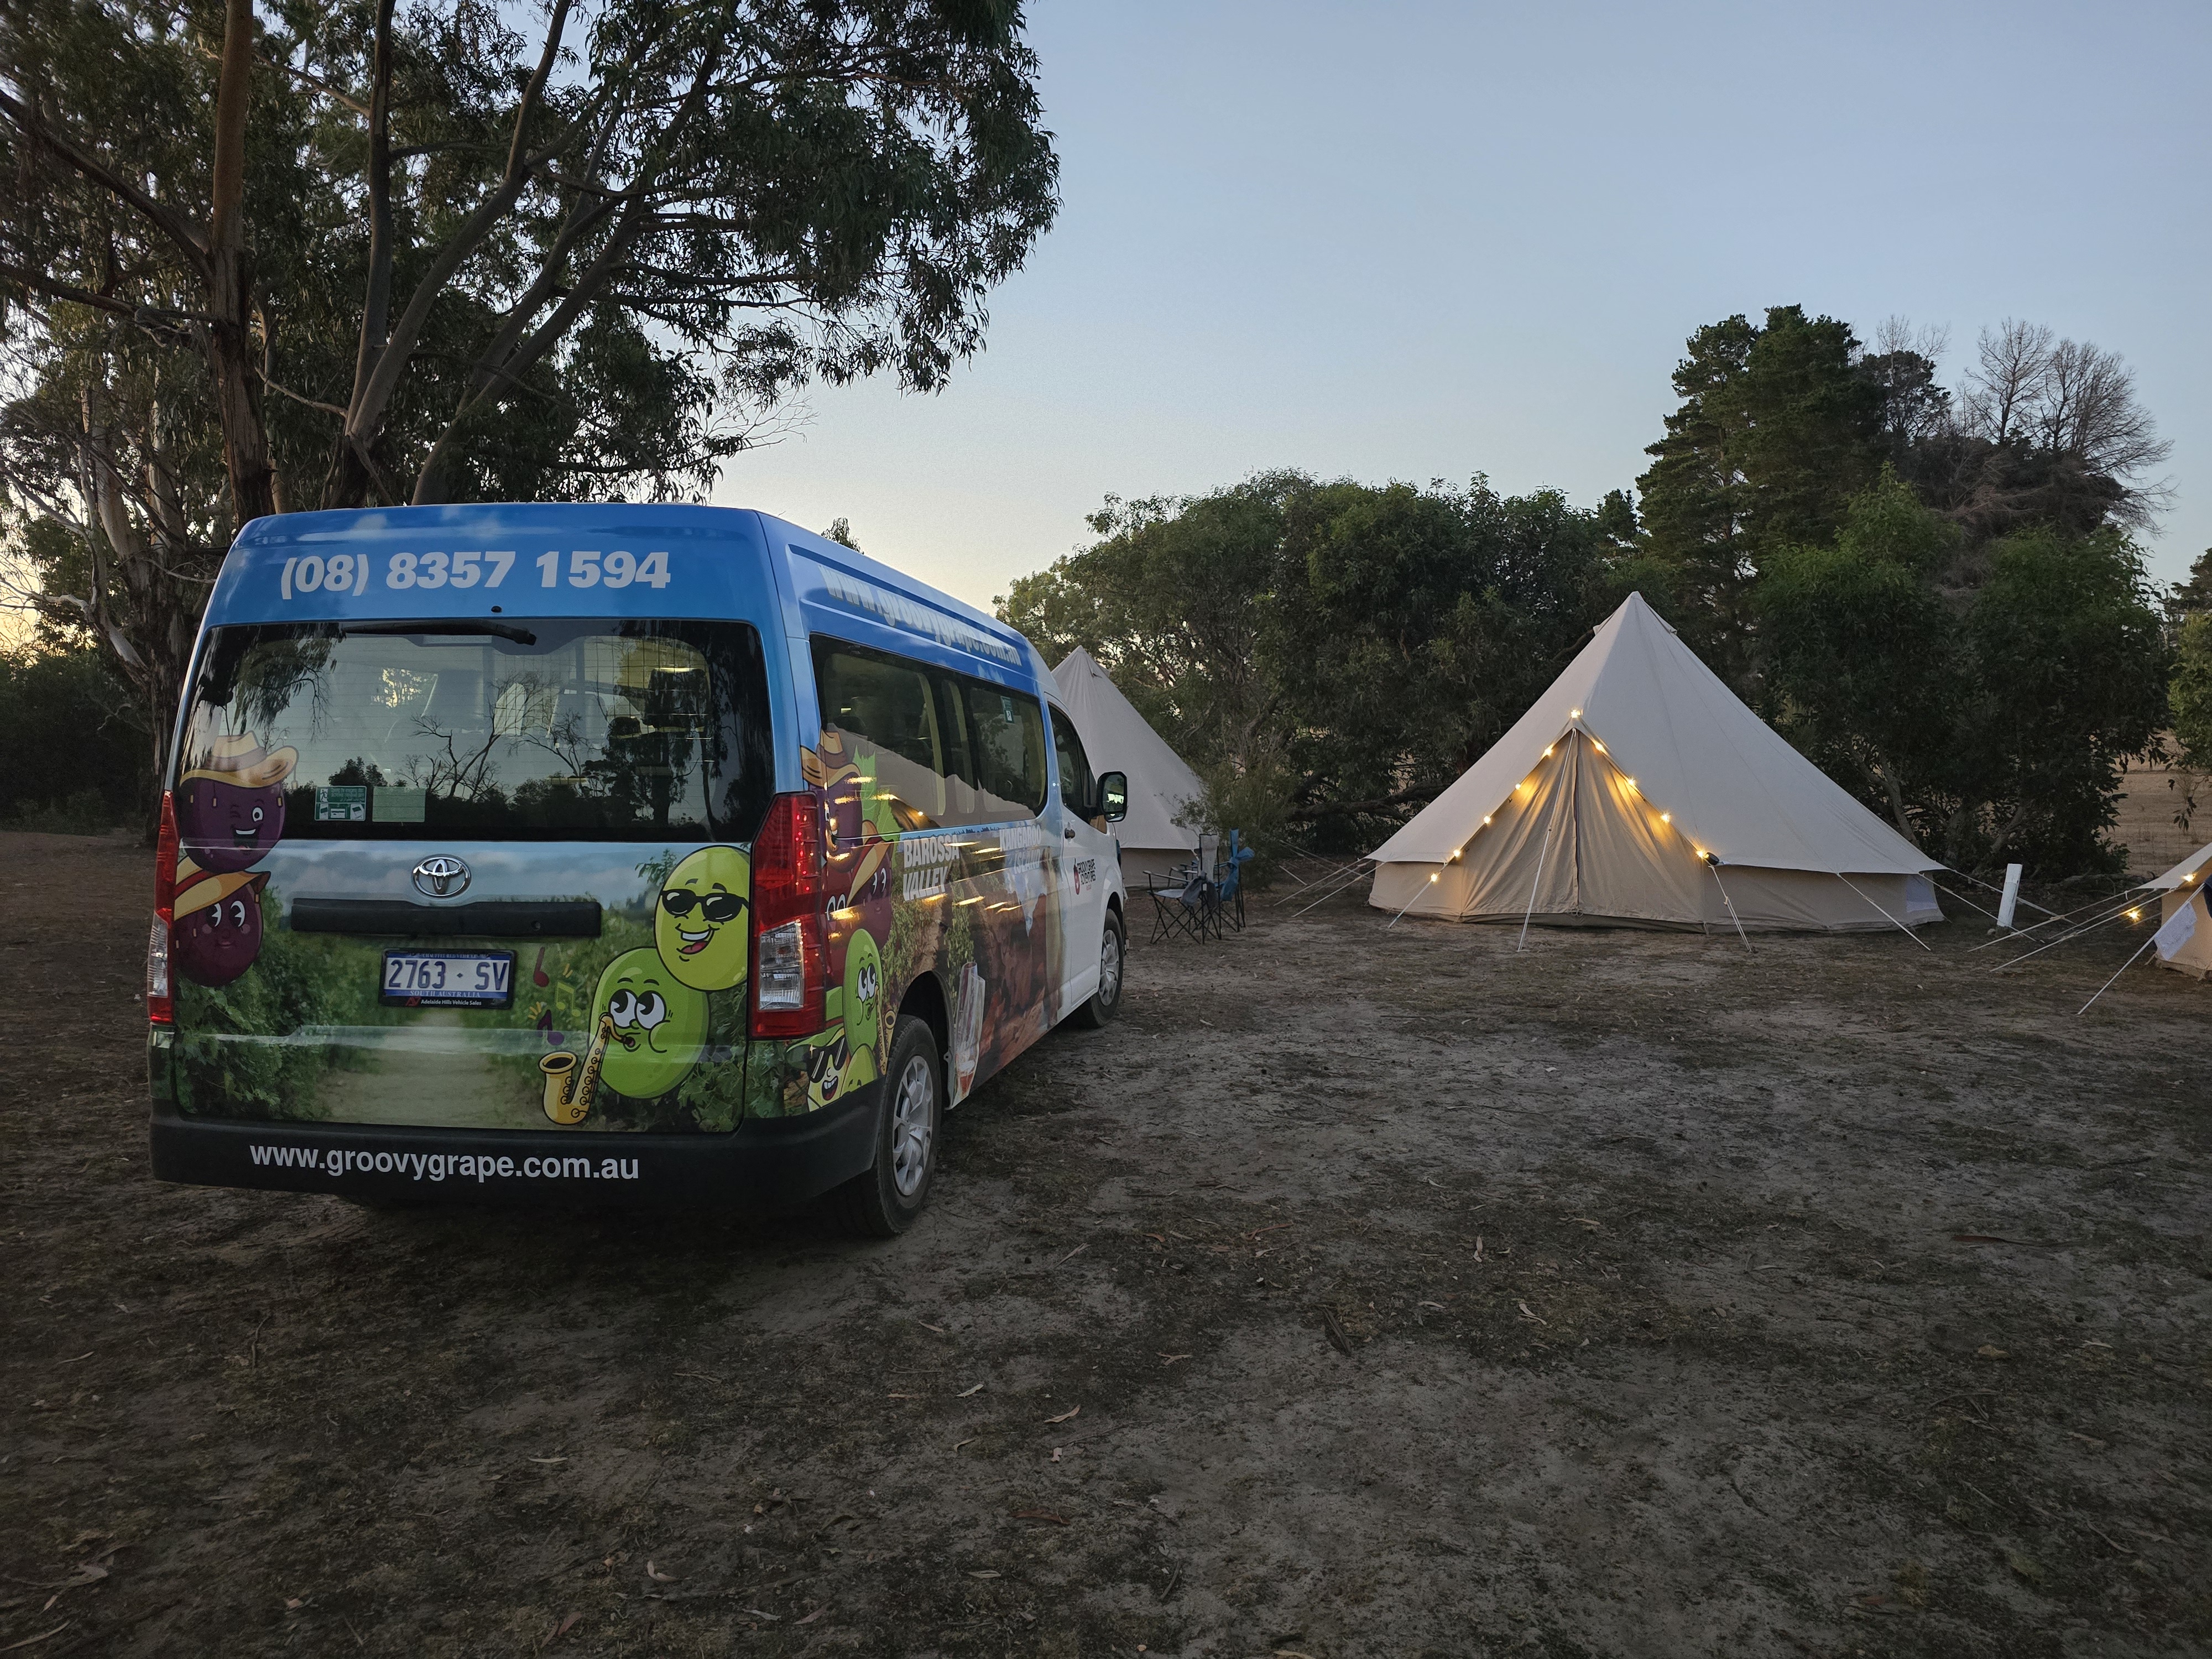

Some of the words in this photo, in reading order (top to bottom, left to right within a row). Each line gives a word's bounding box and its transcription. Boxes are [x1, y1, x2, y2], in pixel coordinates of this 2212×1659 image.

[281, 554, 369, 599] (08)
[386, 551, 516, 589] 8357
[536, 551, 671, 588] 1594
[818, 565, 1022, 666] www.groovygrape.com.au
[904, 834, 959, 868] BAROSSA
[999, 824, 1041, 851] KANGAROO
[1014, 848, 1041, 874] ISLAND
[903, 866, 948, 901] VALLEY
[389, 959, 446, 989] 2763
[475, 962, 508, 990] SV
[249, 1145, 639, 1183] www.groovygrape.com.au
